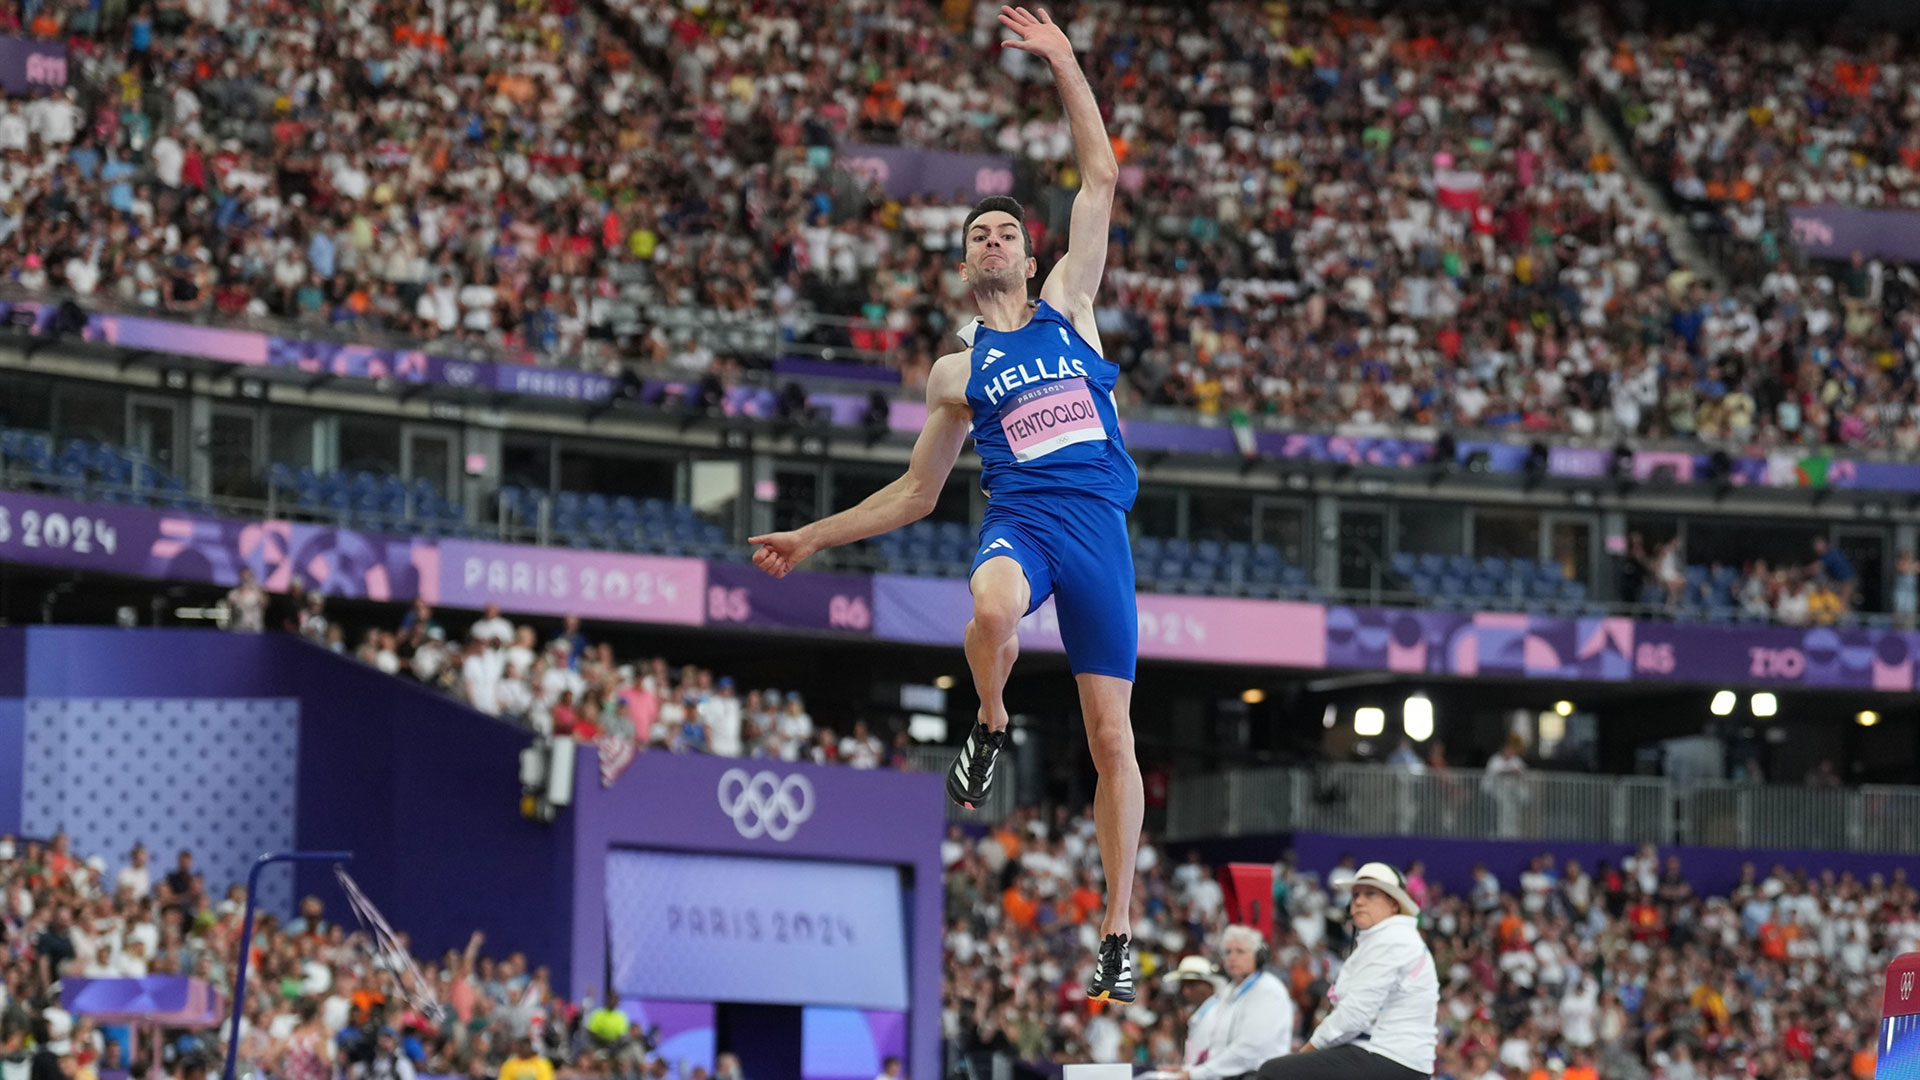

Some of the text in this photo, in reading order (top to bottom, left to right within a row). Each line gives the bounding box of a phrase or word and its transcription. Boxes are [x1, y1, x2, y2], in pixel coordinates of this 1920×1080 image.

[984, 355, 1089, 406] HELLAS
[1017, 384, 1065, 404] PARIS 2024
[1006, 400, 1095, 442] TENTOGLOU
[21, 509, 117, 555] 2024
[464, 557, 677, 604] PARIS 2024
[1137, 612, 1206, 645] 024
[667, 904, 856, 947] PARIS 2024
